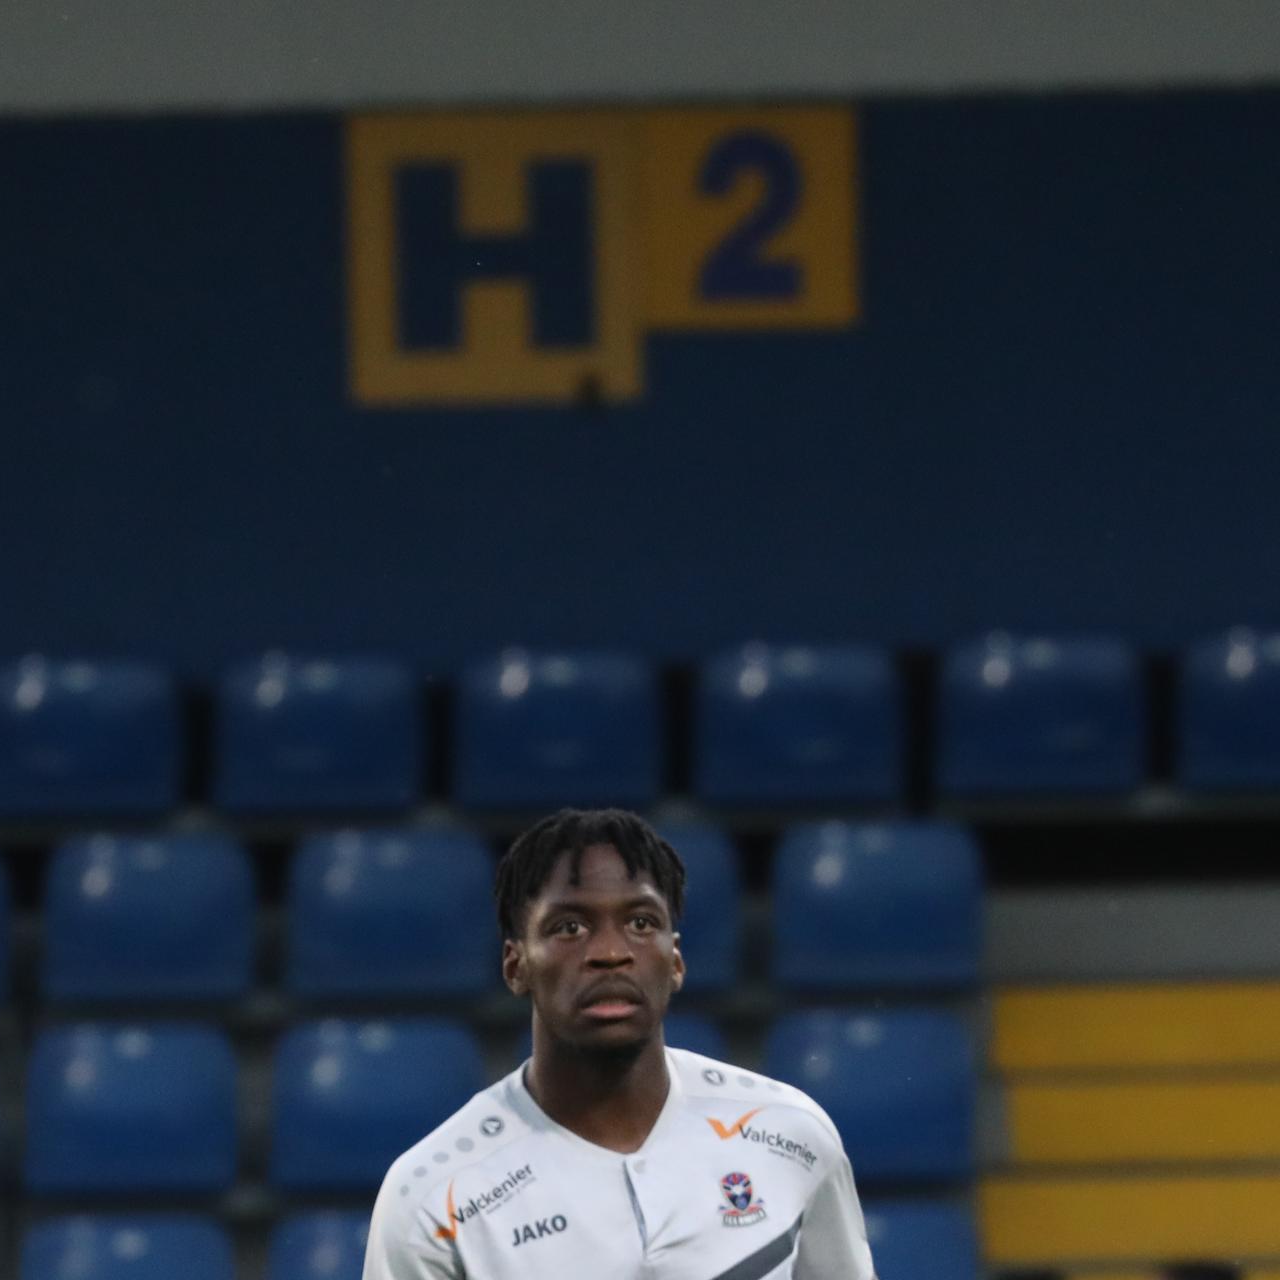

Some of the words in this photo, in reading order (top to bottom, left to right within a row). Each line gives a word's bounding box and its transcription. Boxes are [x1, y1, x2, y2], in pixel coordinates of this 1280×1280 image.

[392, 156, 596, 353] H
[698, 130, 802, 301] 2
[738, 1123, 818, 1166] Valckenier
[451, 1163, 533, 1225] Valckenier
[512, 1214, 568, 1247] JAKO
